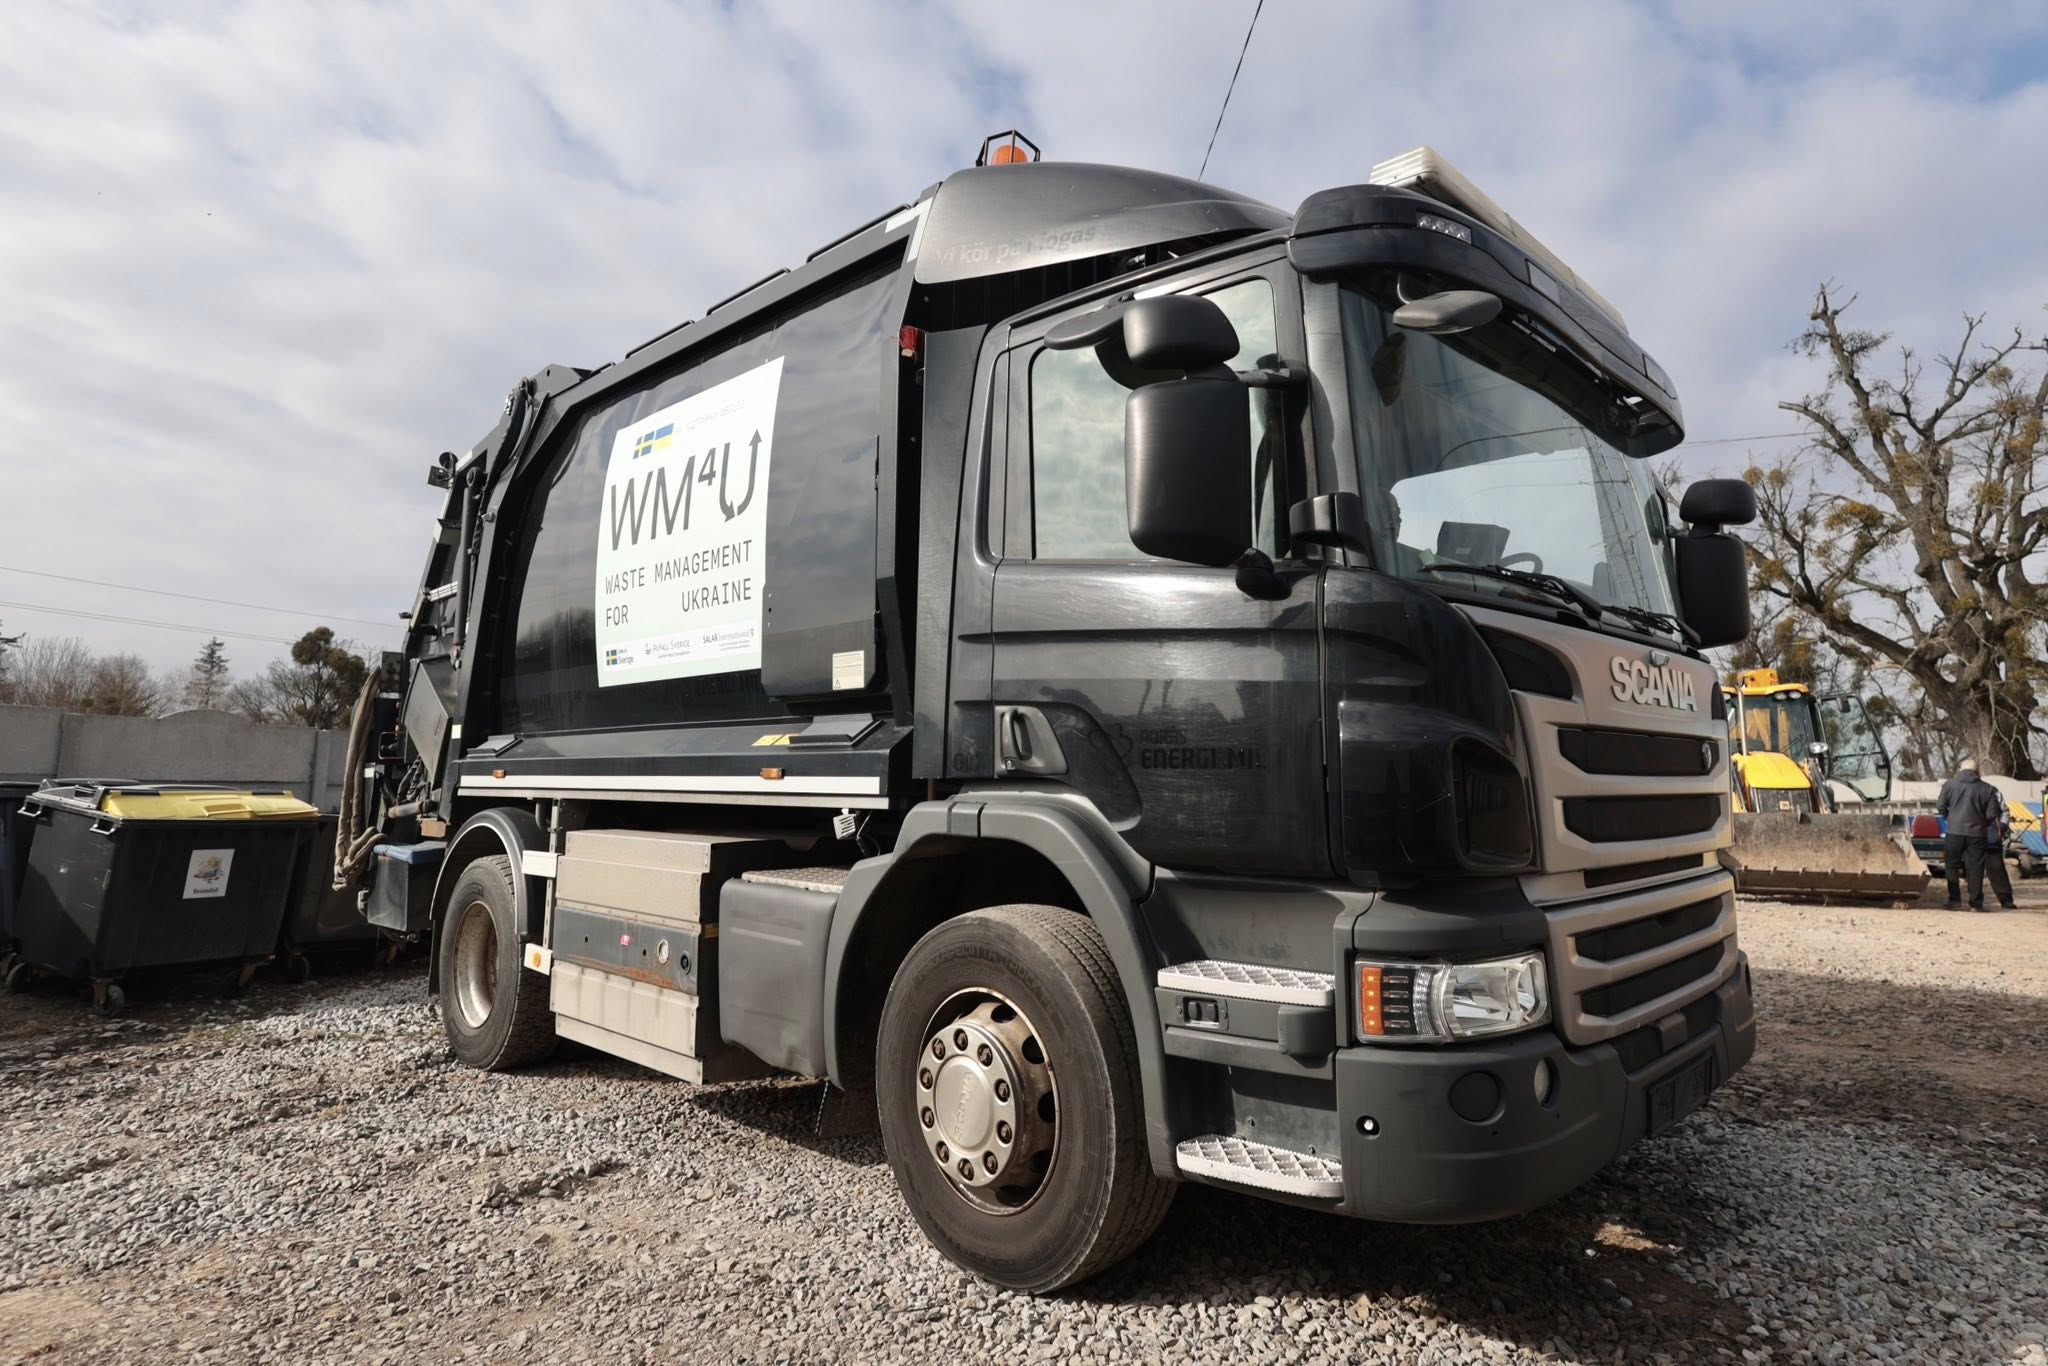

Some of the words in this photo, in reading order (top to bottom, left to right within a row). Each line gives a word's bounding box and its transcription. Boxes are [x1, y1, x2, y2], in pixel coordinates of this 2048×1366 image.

[605, 567, 646, 595] WASTE
[654, 540, 752, 583] MANAGEMENT
[606, 604, 629, 628] FOR
[681, 578, 752, 613] UKRAINE
[1610, 655, 1698, 712] SCANIA
